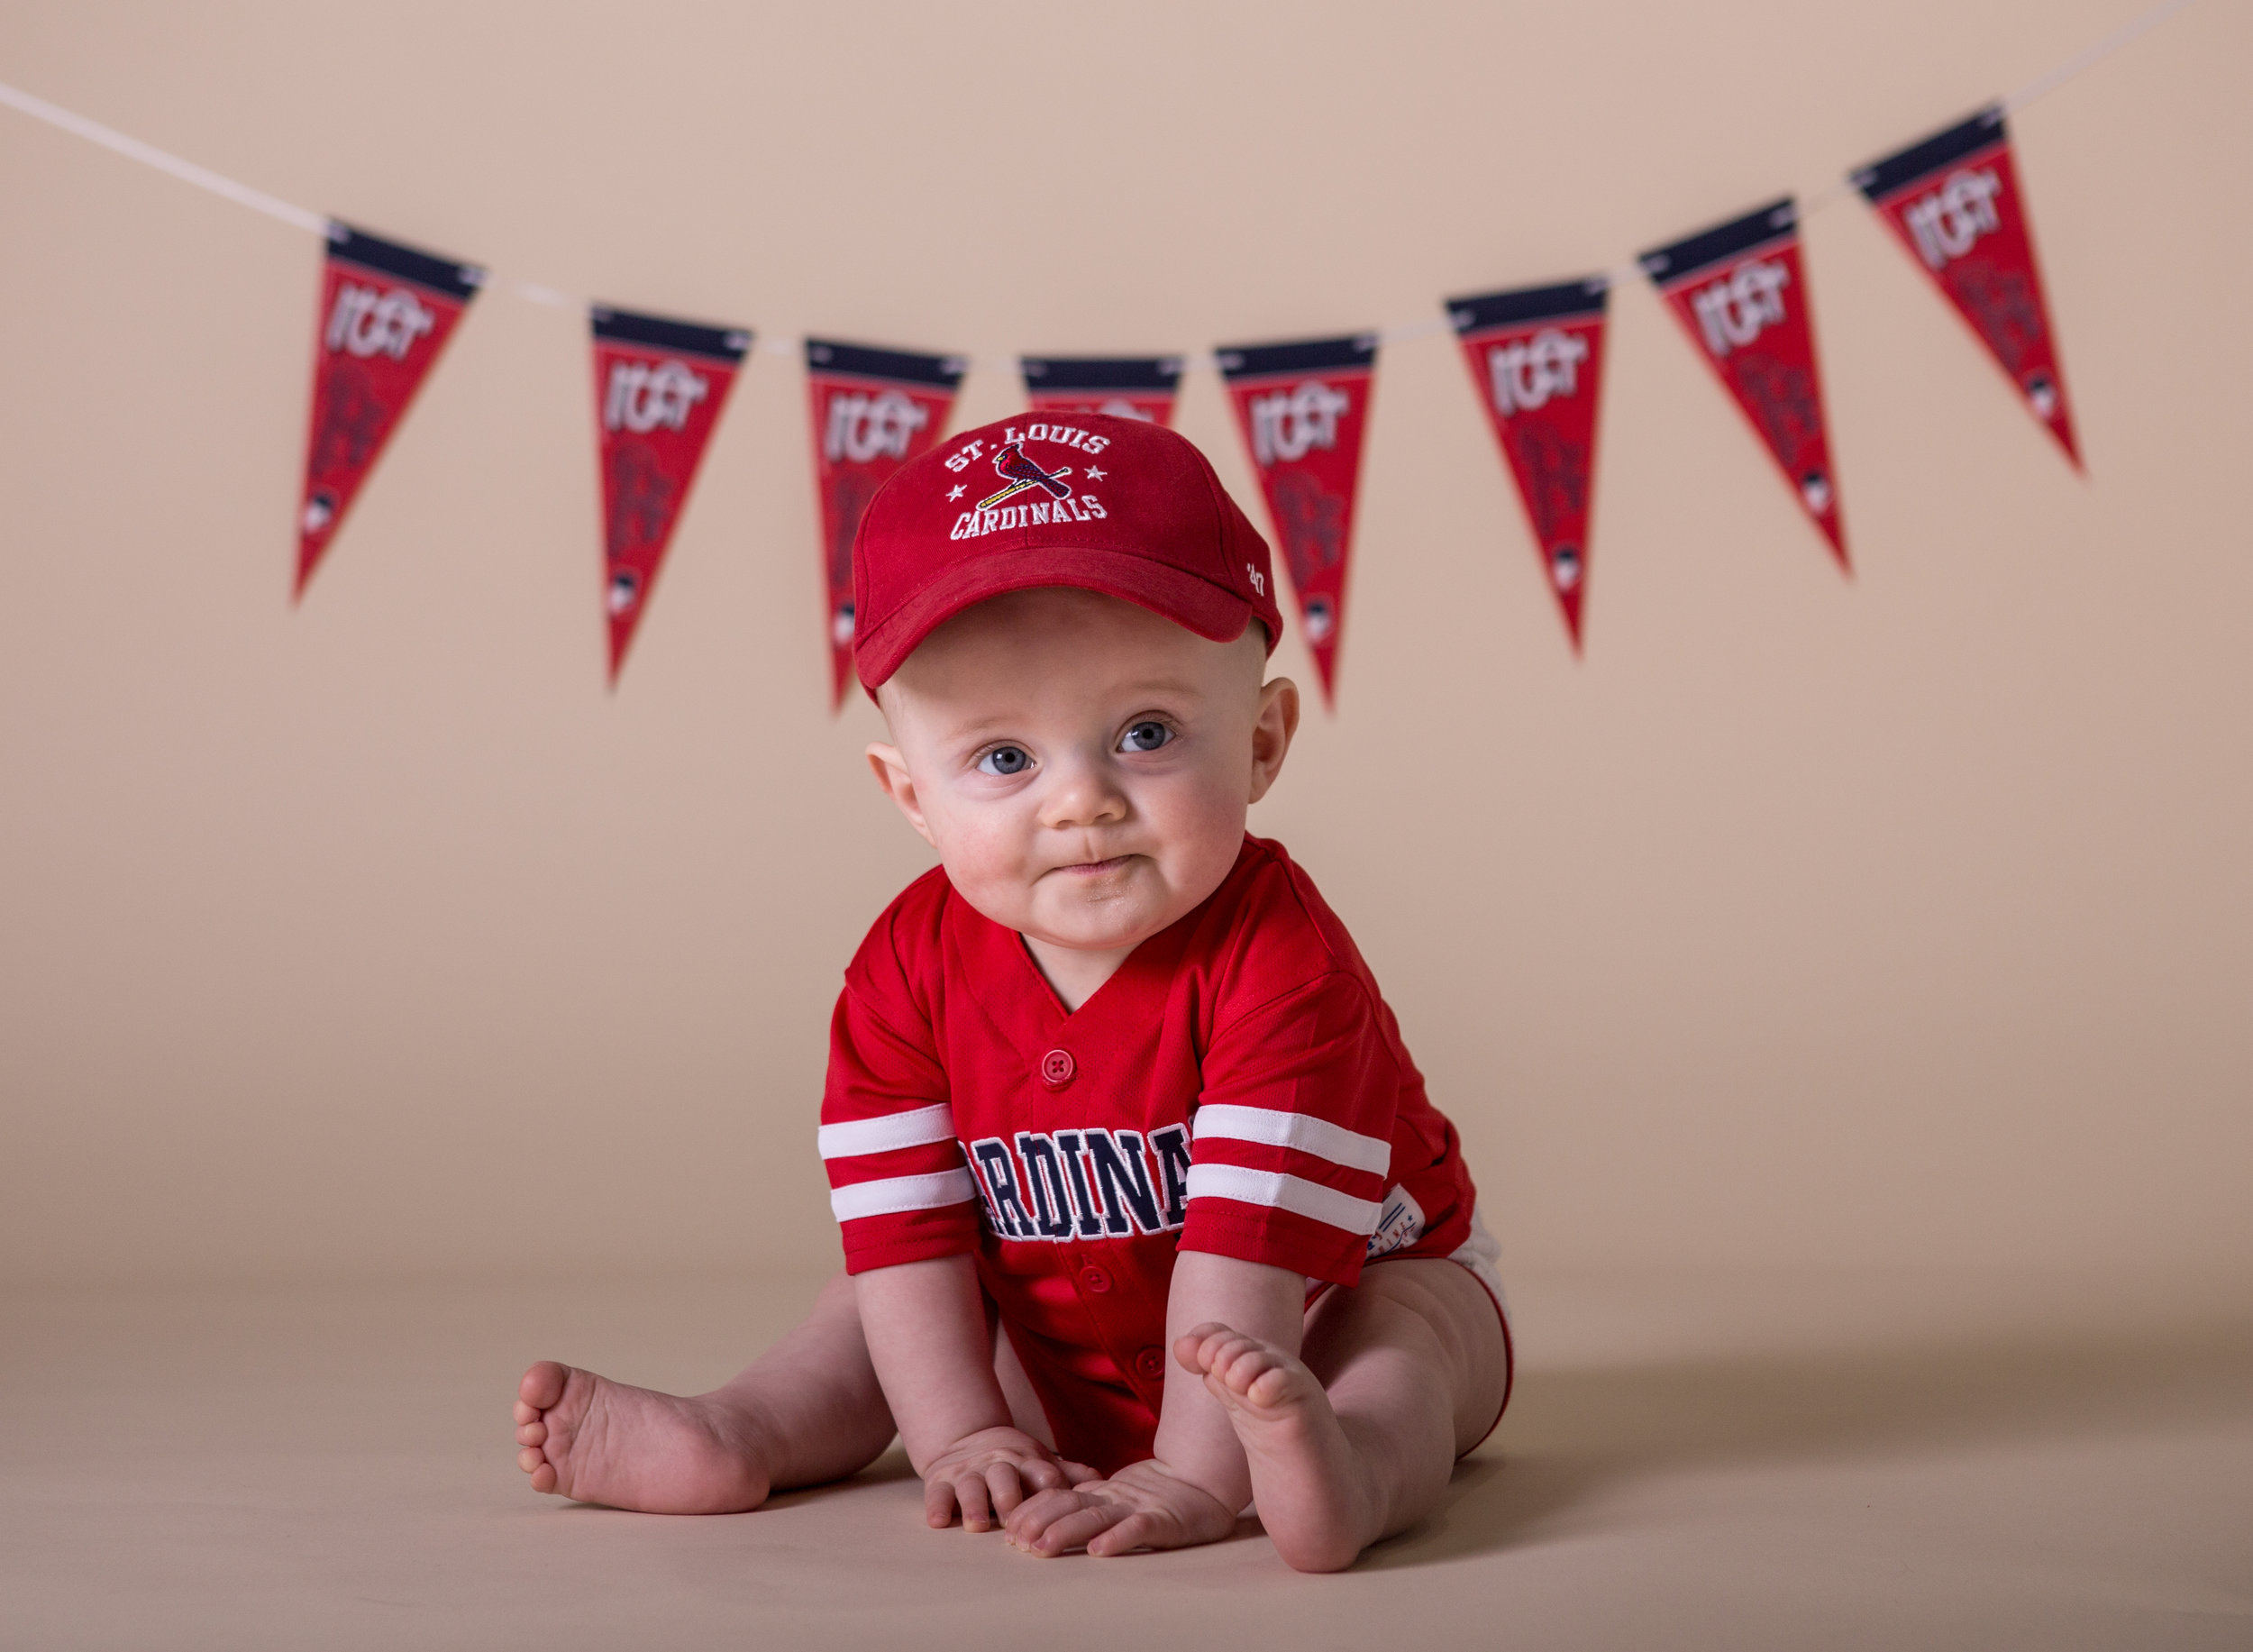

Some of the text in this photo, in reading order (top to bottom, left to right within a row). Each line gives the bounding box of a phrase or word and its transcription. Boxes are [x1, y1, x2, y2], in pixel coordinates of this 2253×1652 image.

[944, 423, 1112, 473] ST. LOUIS
[950, 494, 1108, 541] CARDINALS
